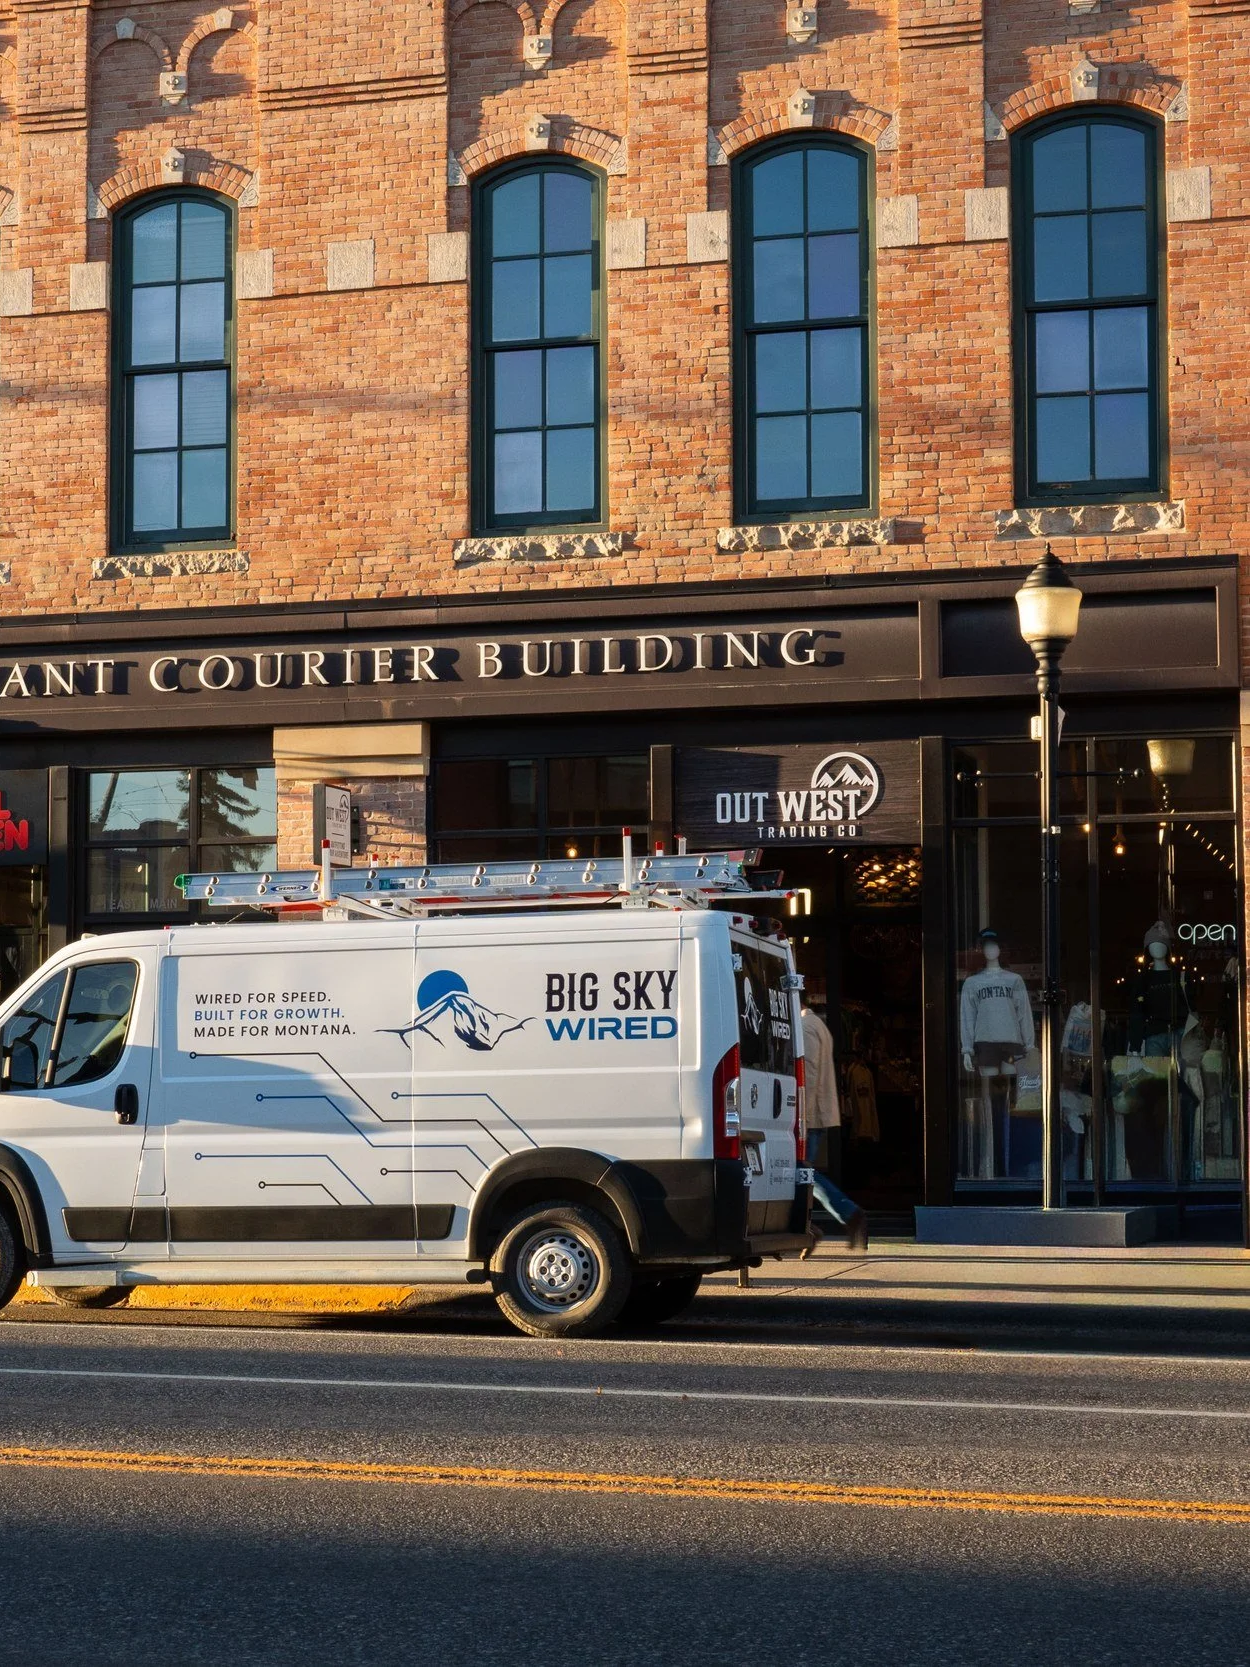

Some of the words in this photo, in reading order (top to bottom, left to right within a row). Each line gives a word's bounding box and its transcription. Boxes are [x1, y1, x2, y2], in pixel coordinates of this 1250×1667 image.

[149, 645, 440, 692] COURIER
[475, 628, 816, 679] BUILDING
[716, 791, 769, 824] OUT
[776, 789, 861, 823] WEST
[757, 825, 827, 839] TRADING
[837, 824, 856, 837] CO
[111, 899, 136, 910] EAST
[150, 899, 178, 909] MAIN
[1178, 923, 1236, 945] open
[196, 993, 242, 1004] WIRED
[248, 993, 276, 1003] FOR
[282, 992, 331, 1002] SPEED.
[545, 972, 600, 1012] BIG
[613, 970, 678, 1010] SKY
[194, 1010, 234, 1021] BUILT
[240, 1009, 268, 1020] FOR
[274, 1008, 345, 1019] GROWTH.
[194, 1026, 235, 1037] MADE
[241, 1026, 269, 1036] FOR
[275, 1024, 356, 1036] MONTANA.
[545, 1016, 678, 1041] WIRED
